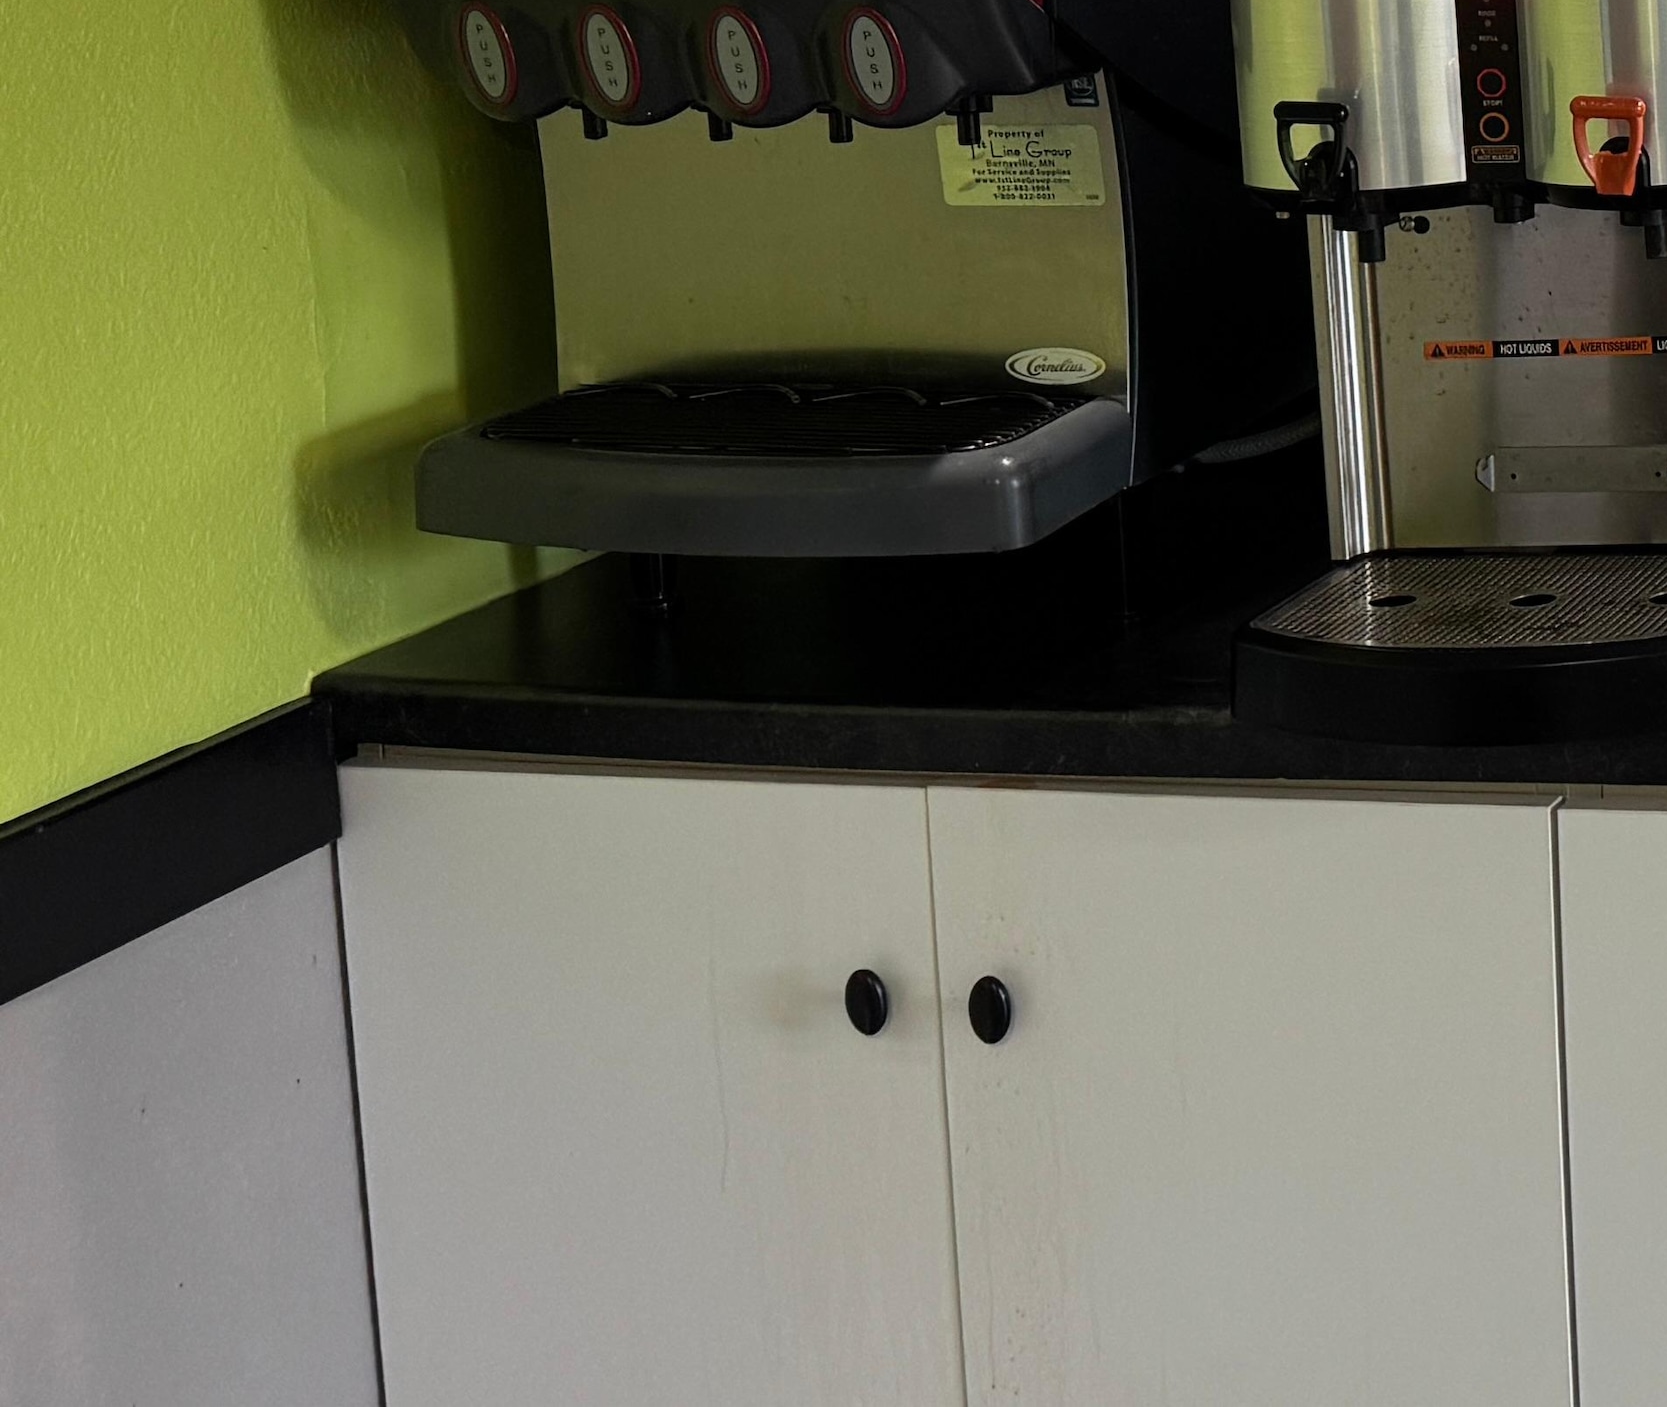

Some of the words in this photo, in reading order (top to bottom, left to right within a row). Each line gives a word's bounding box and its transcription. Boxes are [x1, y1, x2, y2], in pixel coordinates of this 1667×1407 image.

[476, 25, 496, 82] PUSH
[598, 28, 618, 87] PUSH
[728, 30, 747, 89] PUSH
[863, 31, 882, 90] PUSH
[988, 130, 1030, 139] Property
[990, 140, 1021, 157] Line
[1025, 140, 1072, 158] Group
[1027, 355, 1084, 376] Cornelius
[1446, 344, 1485, 356] WARNING
[1500, 343, 1517, 355] HOT
[1519, 342, 1552, 354] LIQUIDS
[1579, 340, 1648, 353] AVERTISSEMENT
